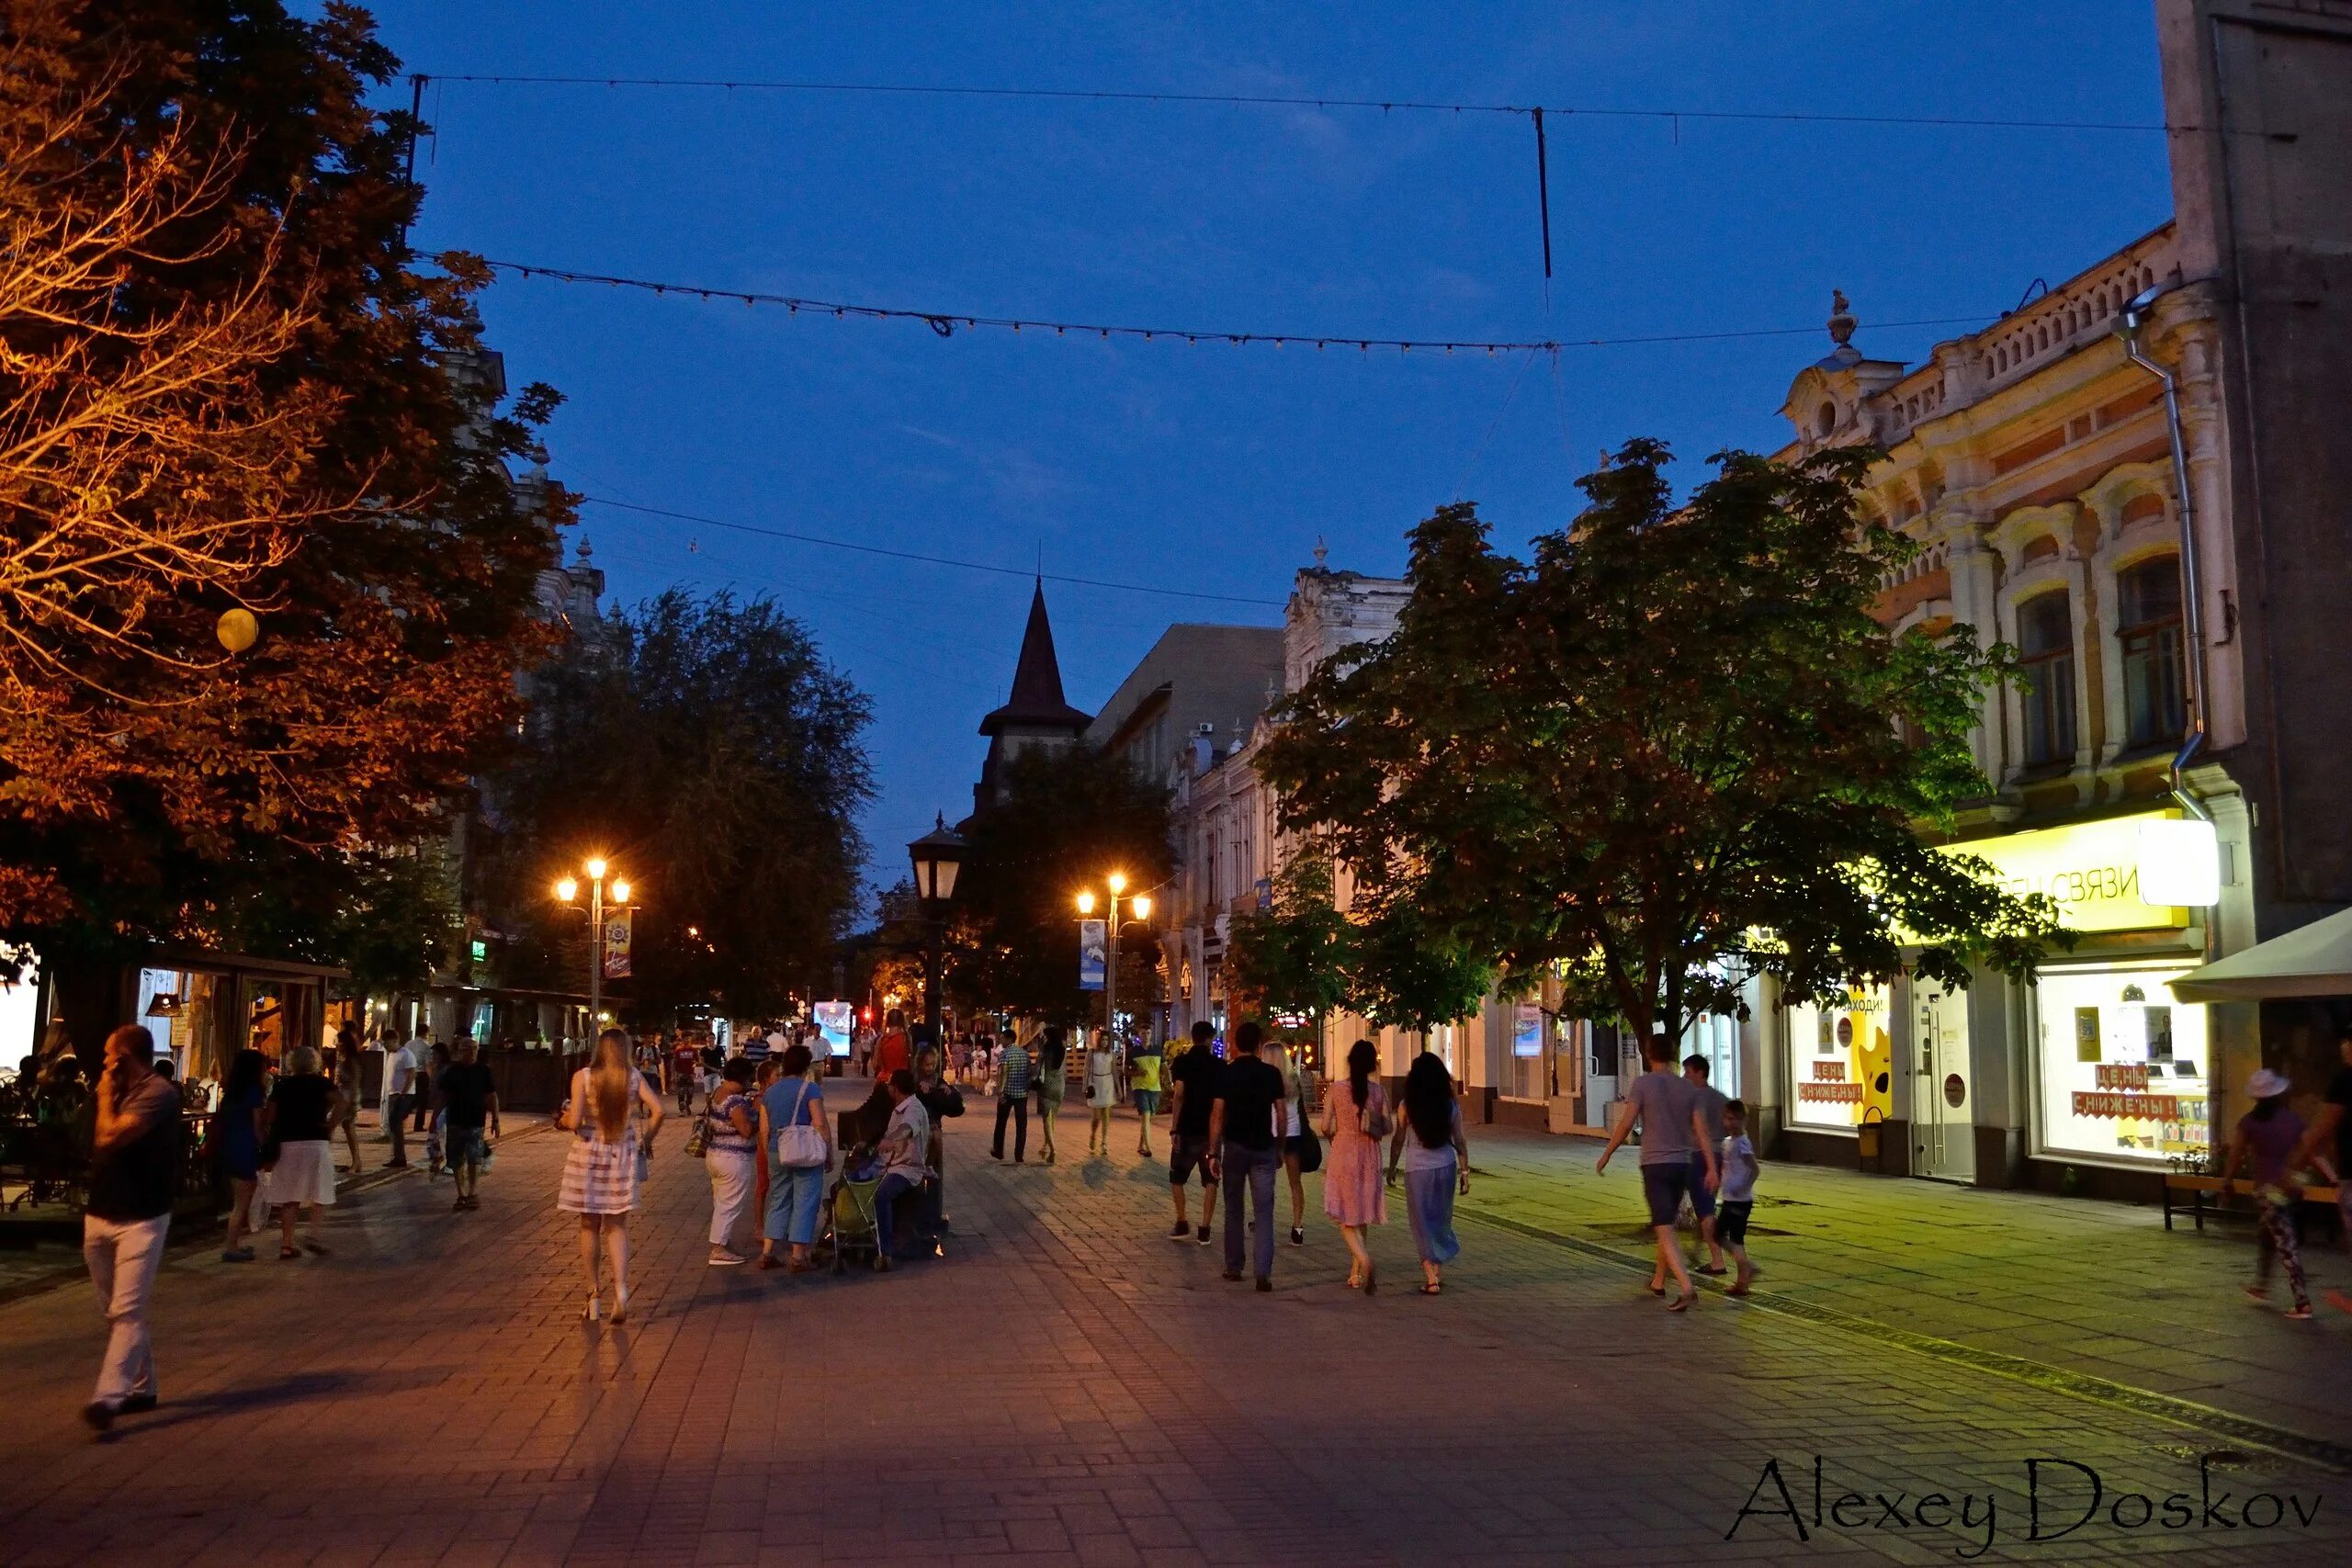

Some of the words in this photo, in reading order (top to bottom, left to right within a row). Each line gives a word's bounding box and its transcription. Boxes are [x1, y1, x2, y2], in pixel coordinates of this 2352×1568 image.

[2052, 864, 2139, 903] СВЯЗИ
[1814, 1064, 1845, 1077] ЦЕНЫ
[2097, 1067, 2148, 1085] ЦЕНЫ
